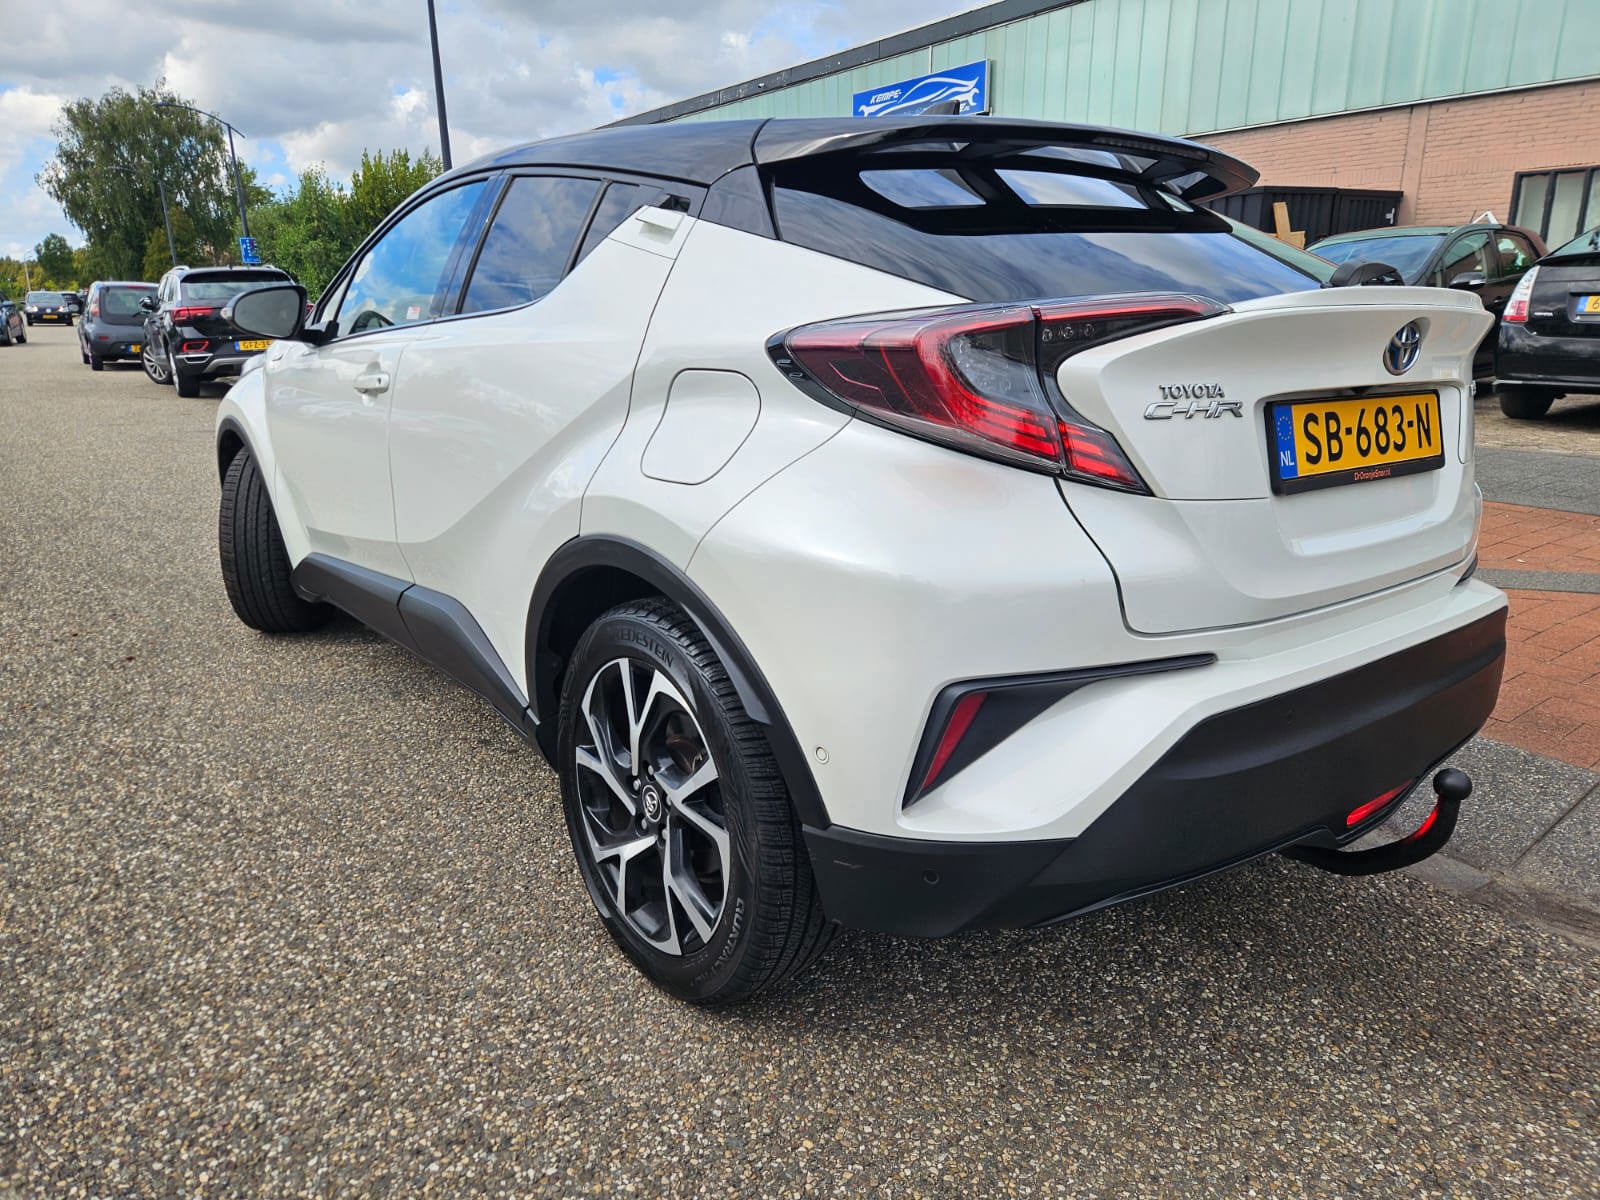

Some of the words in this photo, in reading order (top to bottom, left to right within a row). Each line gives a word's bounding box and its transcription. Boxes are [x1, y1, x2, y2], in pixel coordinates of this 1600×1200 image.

[1159, 383, 1225, 400] TOYOTA
[1144, 401, 1243, 420] C-HR
[1303, 403, 1432, 465] SB-683-N
[1280, 451, 1295, 467] NL
